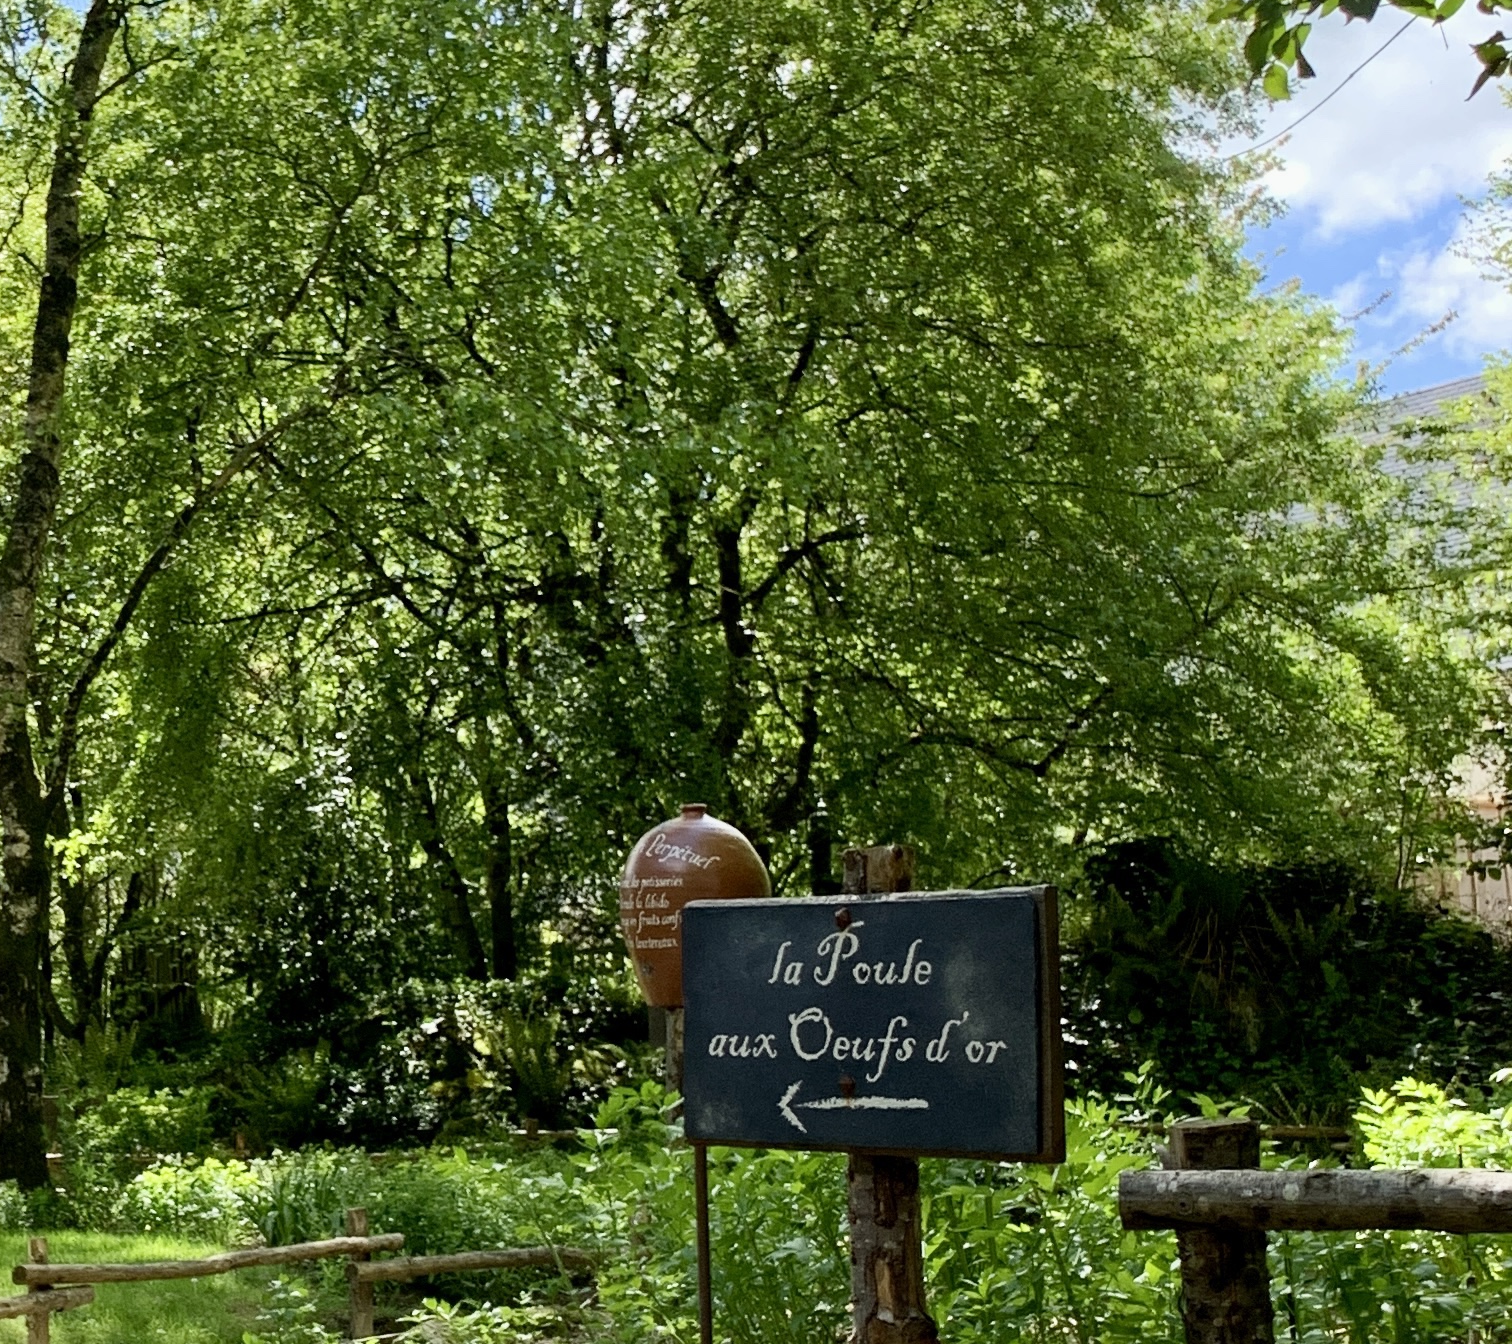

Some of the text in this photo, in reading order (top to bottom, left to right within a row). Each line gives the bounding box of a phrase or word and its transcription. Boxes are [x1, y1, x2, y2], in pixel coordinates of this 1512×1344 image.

[645, 892, 670, 908] libido
[636, 911, 660, 934] fruits
[768, 920, 932, 986] la Poule
[708, 1032, 778, 1059] aux
[788, 1007, 917, 1083] Oeufs
